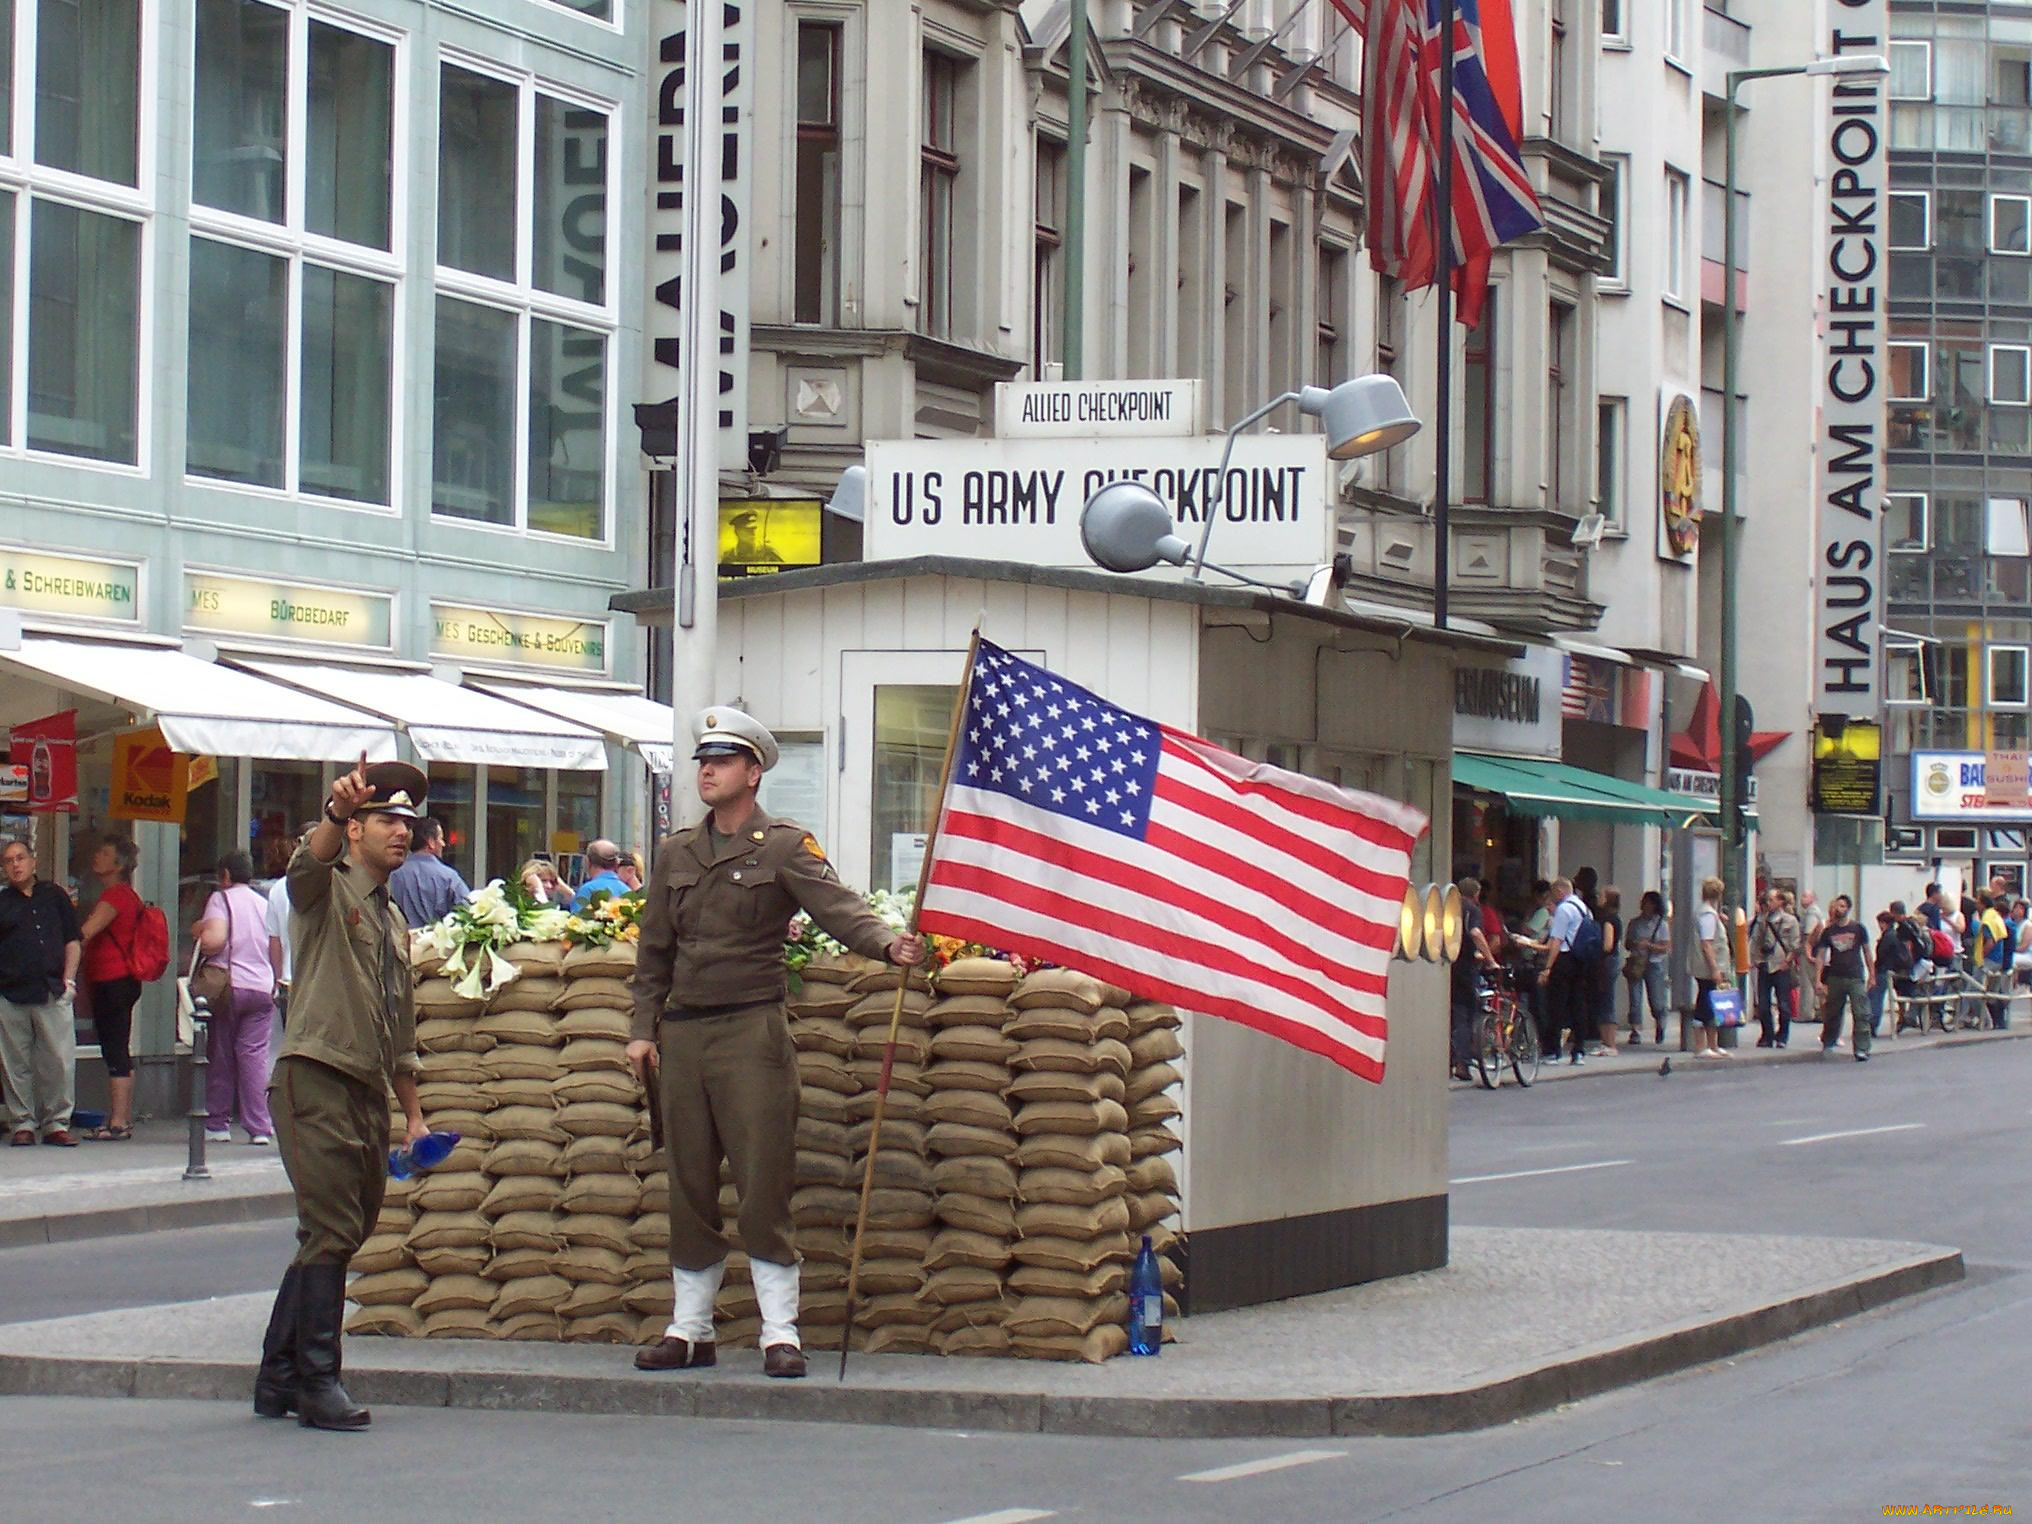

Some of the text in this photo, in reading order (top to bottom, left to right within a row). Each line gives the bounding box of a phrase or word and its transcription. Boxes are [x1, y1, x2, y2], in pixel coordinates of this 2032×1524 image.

[1022, 390, 1173, 423] ALLIED CHECKPOINT
[1827, 424, 1874, 520] AM
[892, 466, 1306, 525] US ARMY CCKPOINT
[5, 568, 16, 591] &
[1825, 540, 1873, 694] HAUS
[123, 792, 171, 810] Kodak
